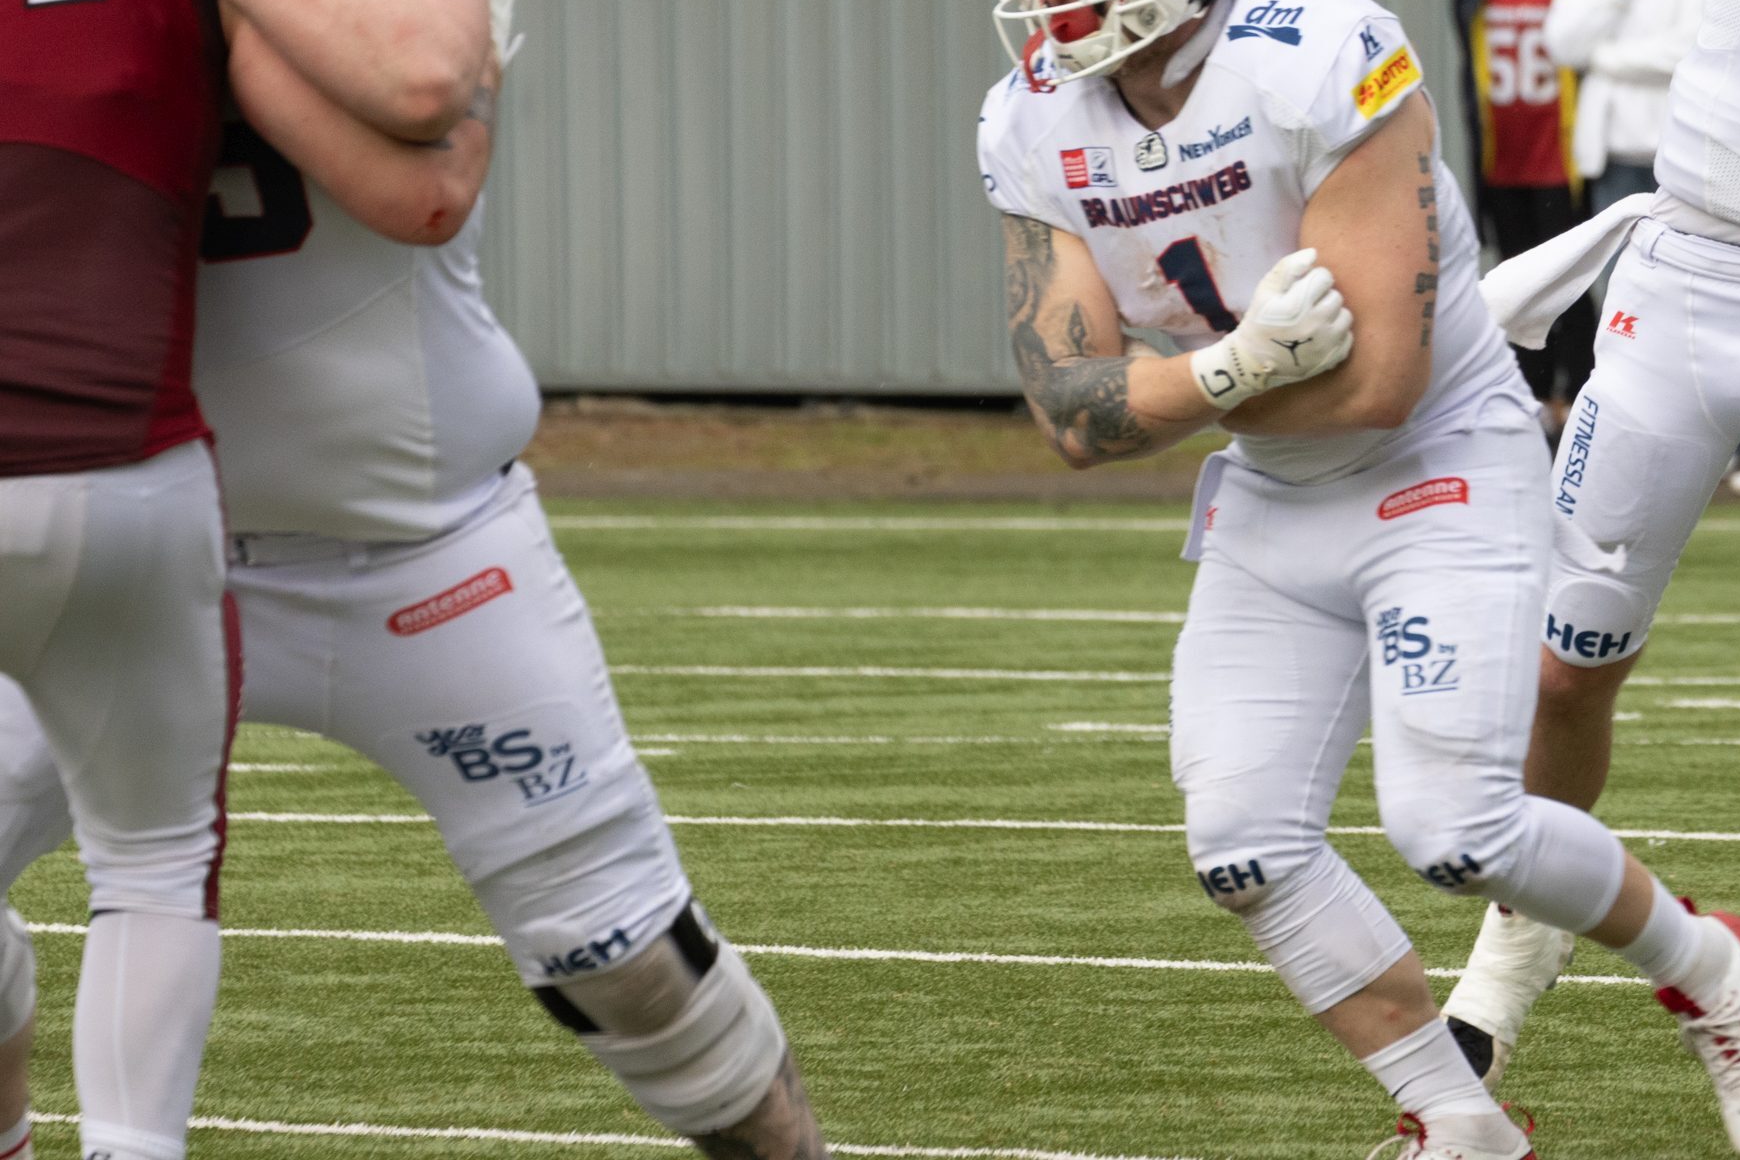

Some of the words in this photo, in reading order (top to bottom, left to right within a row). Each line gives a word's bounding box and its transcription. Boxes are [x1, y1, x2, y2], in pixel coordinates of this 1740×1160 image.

[1245, 0, 1305, 25] dm
[1373, 55, 1411, 91] LOTTO
[1156, 235, 1240, 333] 1
[1546, 613, 1632, 659] HEH
[1402, 660, 1460, 689] BZ
[452, 730, 543, 783] BS
[514, 755, 586, 800] BZ
